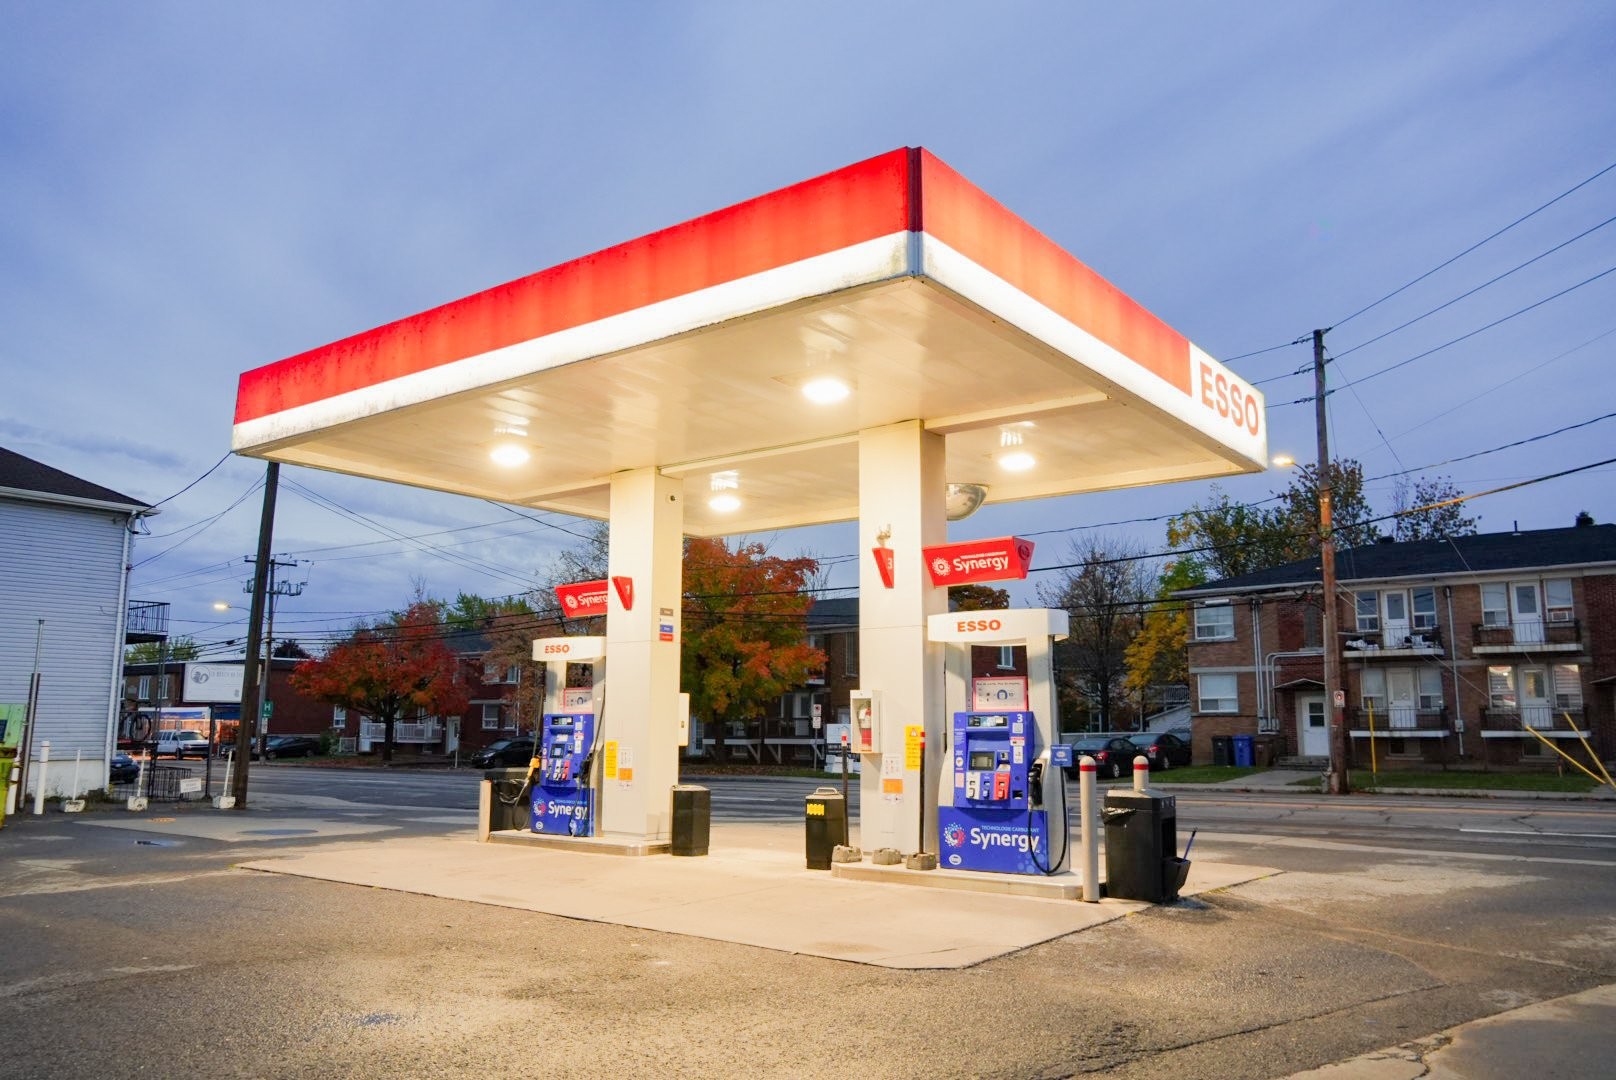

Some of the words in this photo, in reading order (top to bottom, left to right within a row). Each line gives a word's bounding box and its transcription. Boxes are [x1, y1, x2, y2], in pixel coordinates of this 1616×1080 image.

[1200, 361, 1259, 436] ESSO
[887, 557, 893, 569] 3
[953, 556, 1009, 574] Synergy
[957, 619, 1001, 632] ESSO
[544, 644, 570, 654] ESSO
[264, 703, 271, 711] H
[1016, 713, 1023, 723] 3
[970, 827, 1040, 853] Synergy
